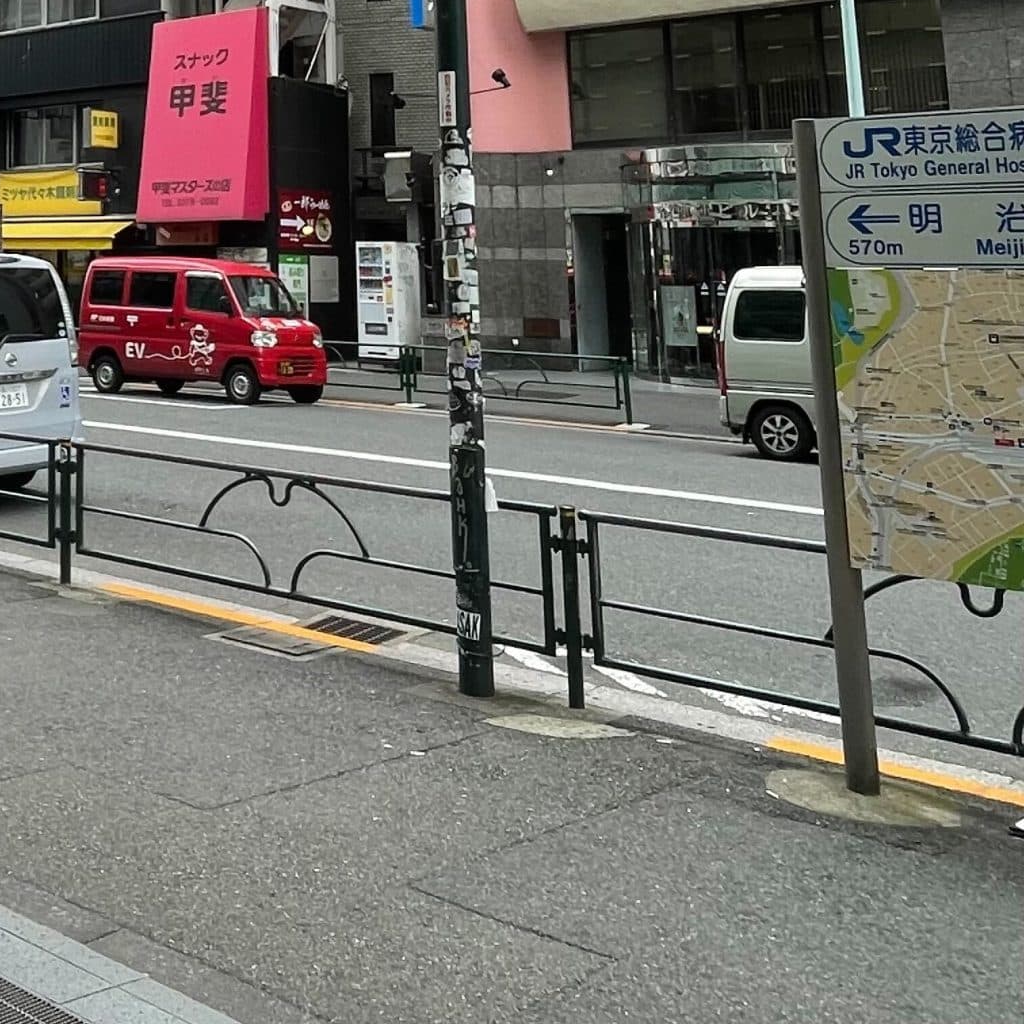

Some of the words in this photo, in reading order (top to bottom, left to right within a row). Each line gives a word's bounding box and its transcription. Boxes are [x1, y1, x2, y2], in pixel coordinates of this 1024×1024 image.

[173, 48, 229, 70] スナック
[169, 80, 229, 117] 甲斐
[846, 163, 865, 180] JR
[871, 162, 918, 181] Tokyo
[924, 157, 990, 176] General
[848, 239, 904, 256] 570m
[125, 341, 146, 359] EV
